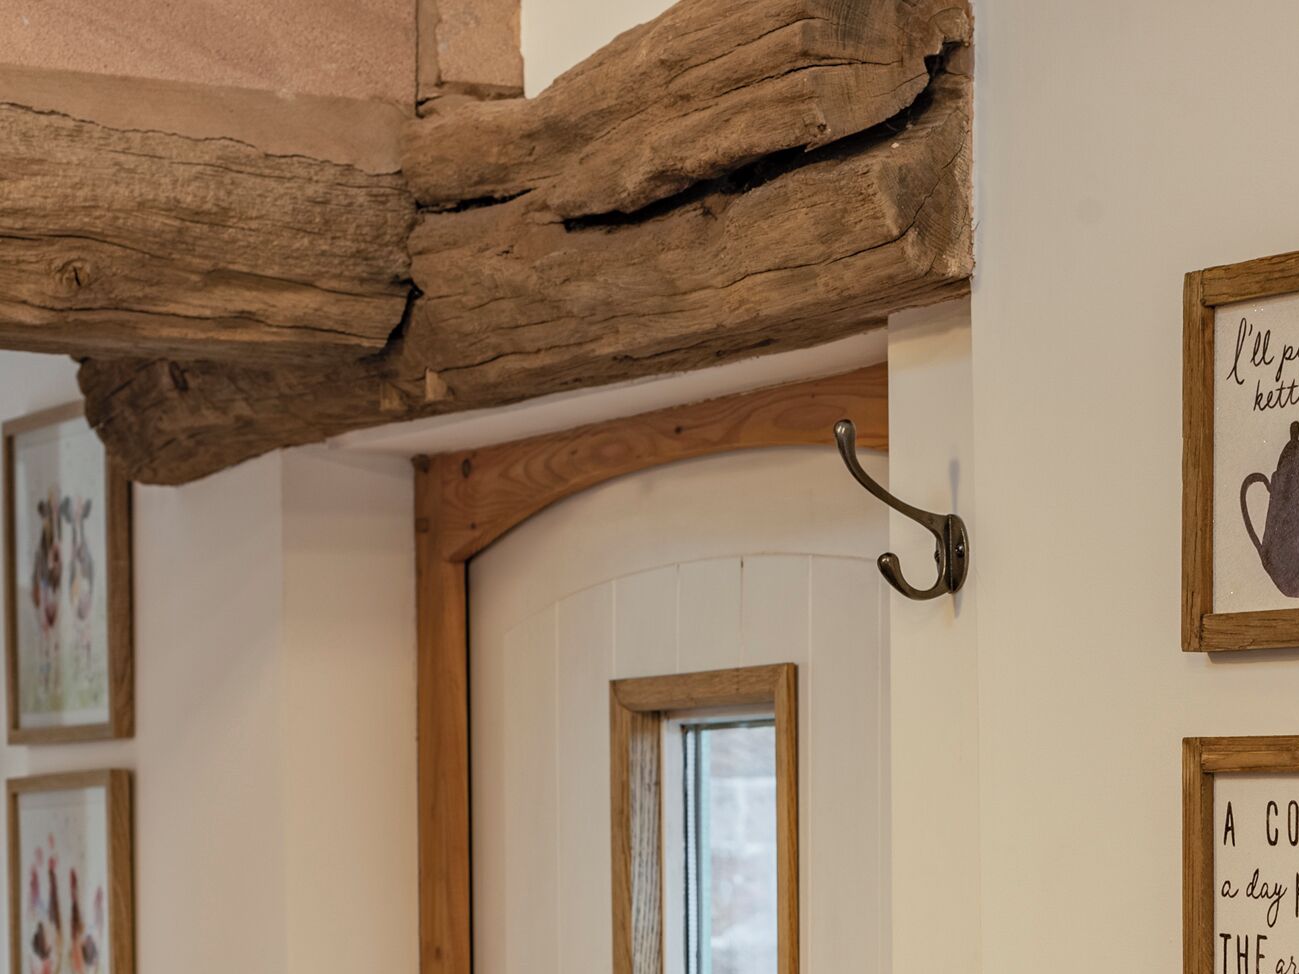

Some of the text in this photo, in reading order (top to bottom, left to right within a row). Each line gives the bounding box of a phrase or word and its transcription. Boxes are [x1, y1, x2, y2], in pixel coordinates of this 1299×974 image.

[1227, 317, 1275, 385] I'll
[1223, 800, 1236, 847] A
[1220, 879, 1239, 899] a
[1246, 868, 1287, 928] day
